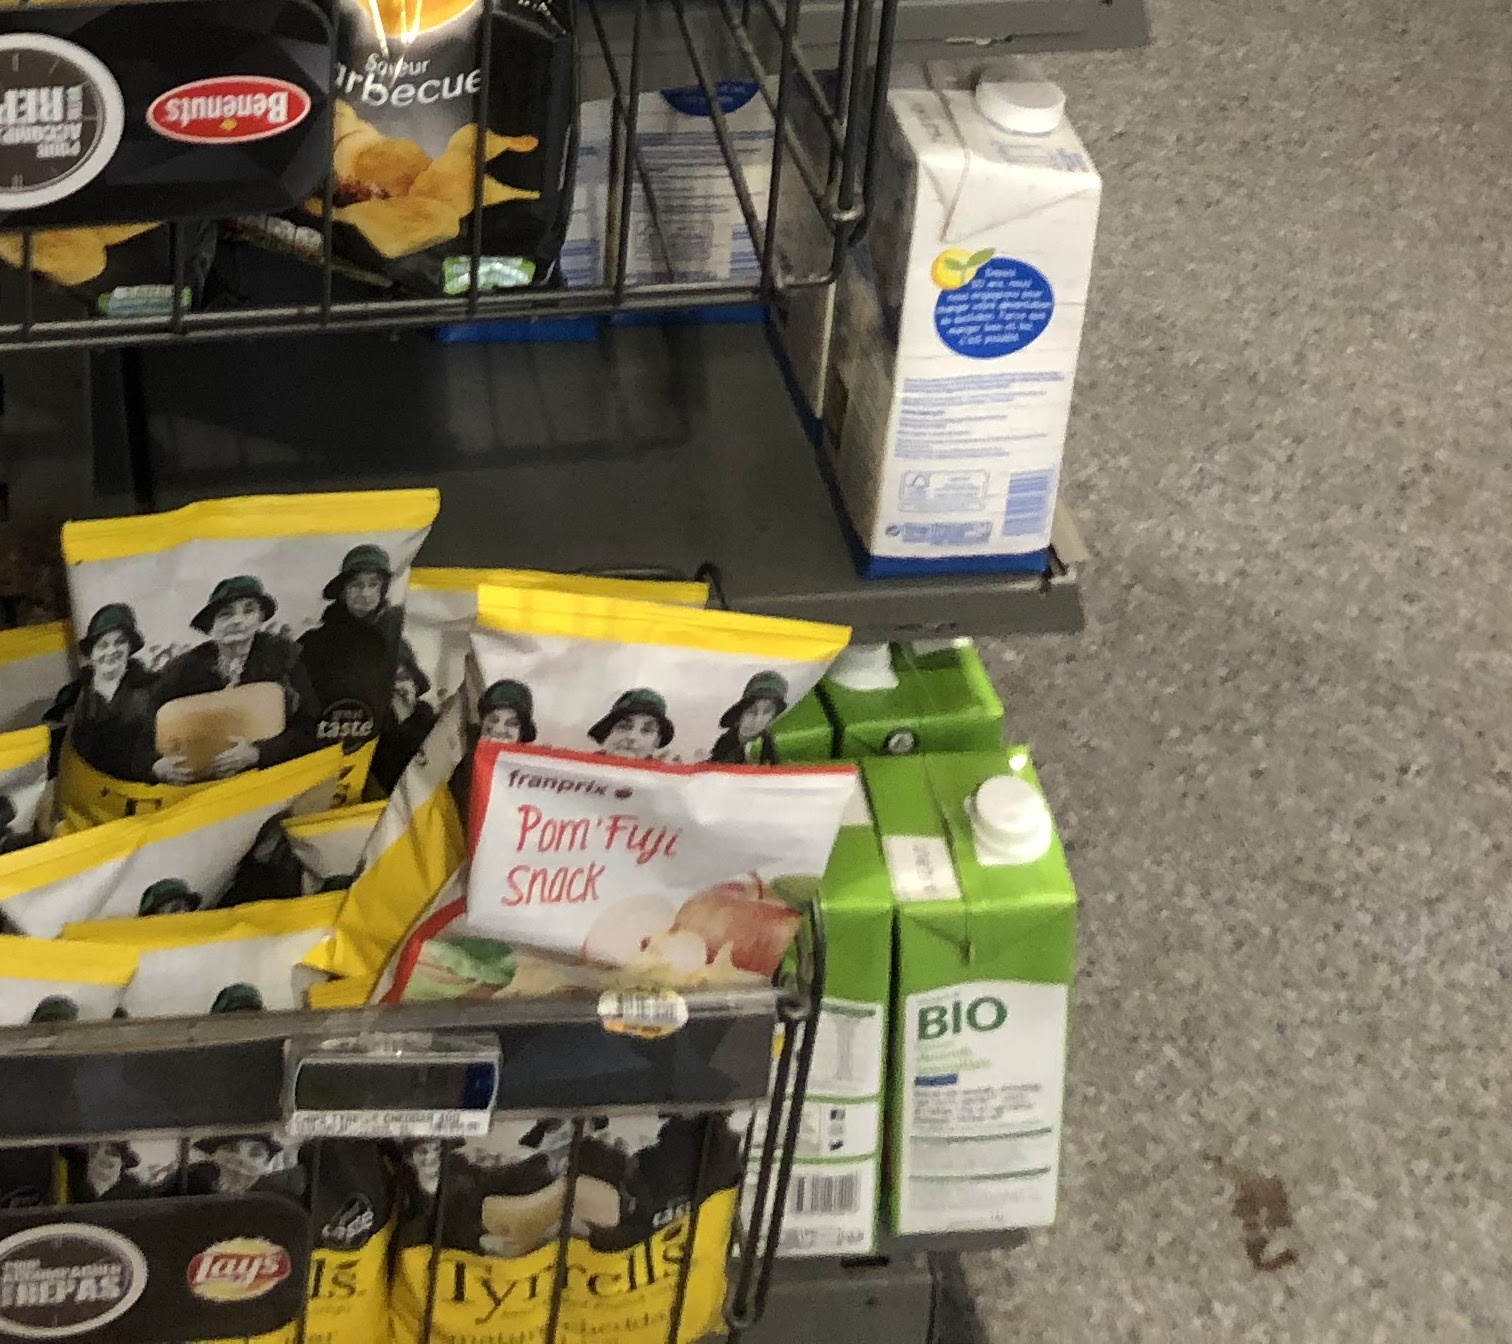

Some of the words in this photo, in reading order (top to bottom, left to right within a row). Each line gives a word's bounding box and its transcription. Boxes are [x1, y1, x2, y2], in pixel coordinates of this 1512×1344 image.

[316, 718, 375, 740] taste
[507, 768, 606, 798] franprix
[918, 996, 1008, 1040] BIO
